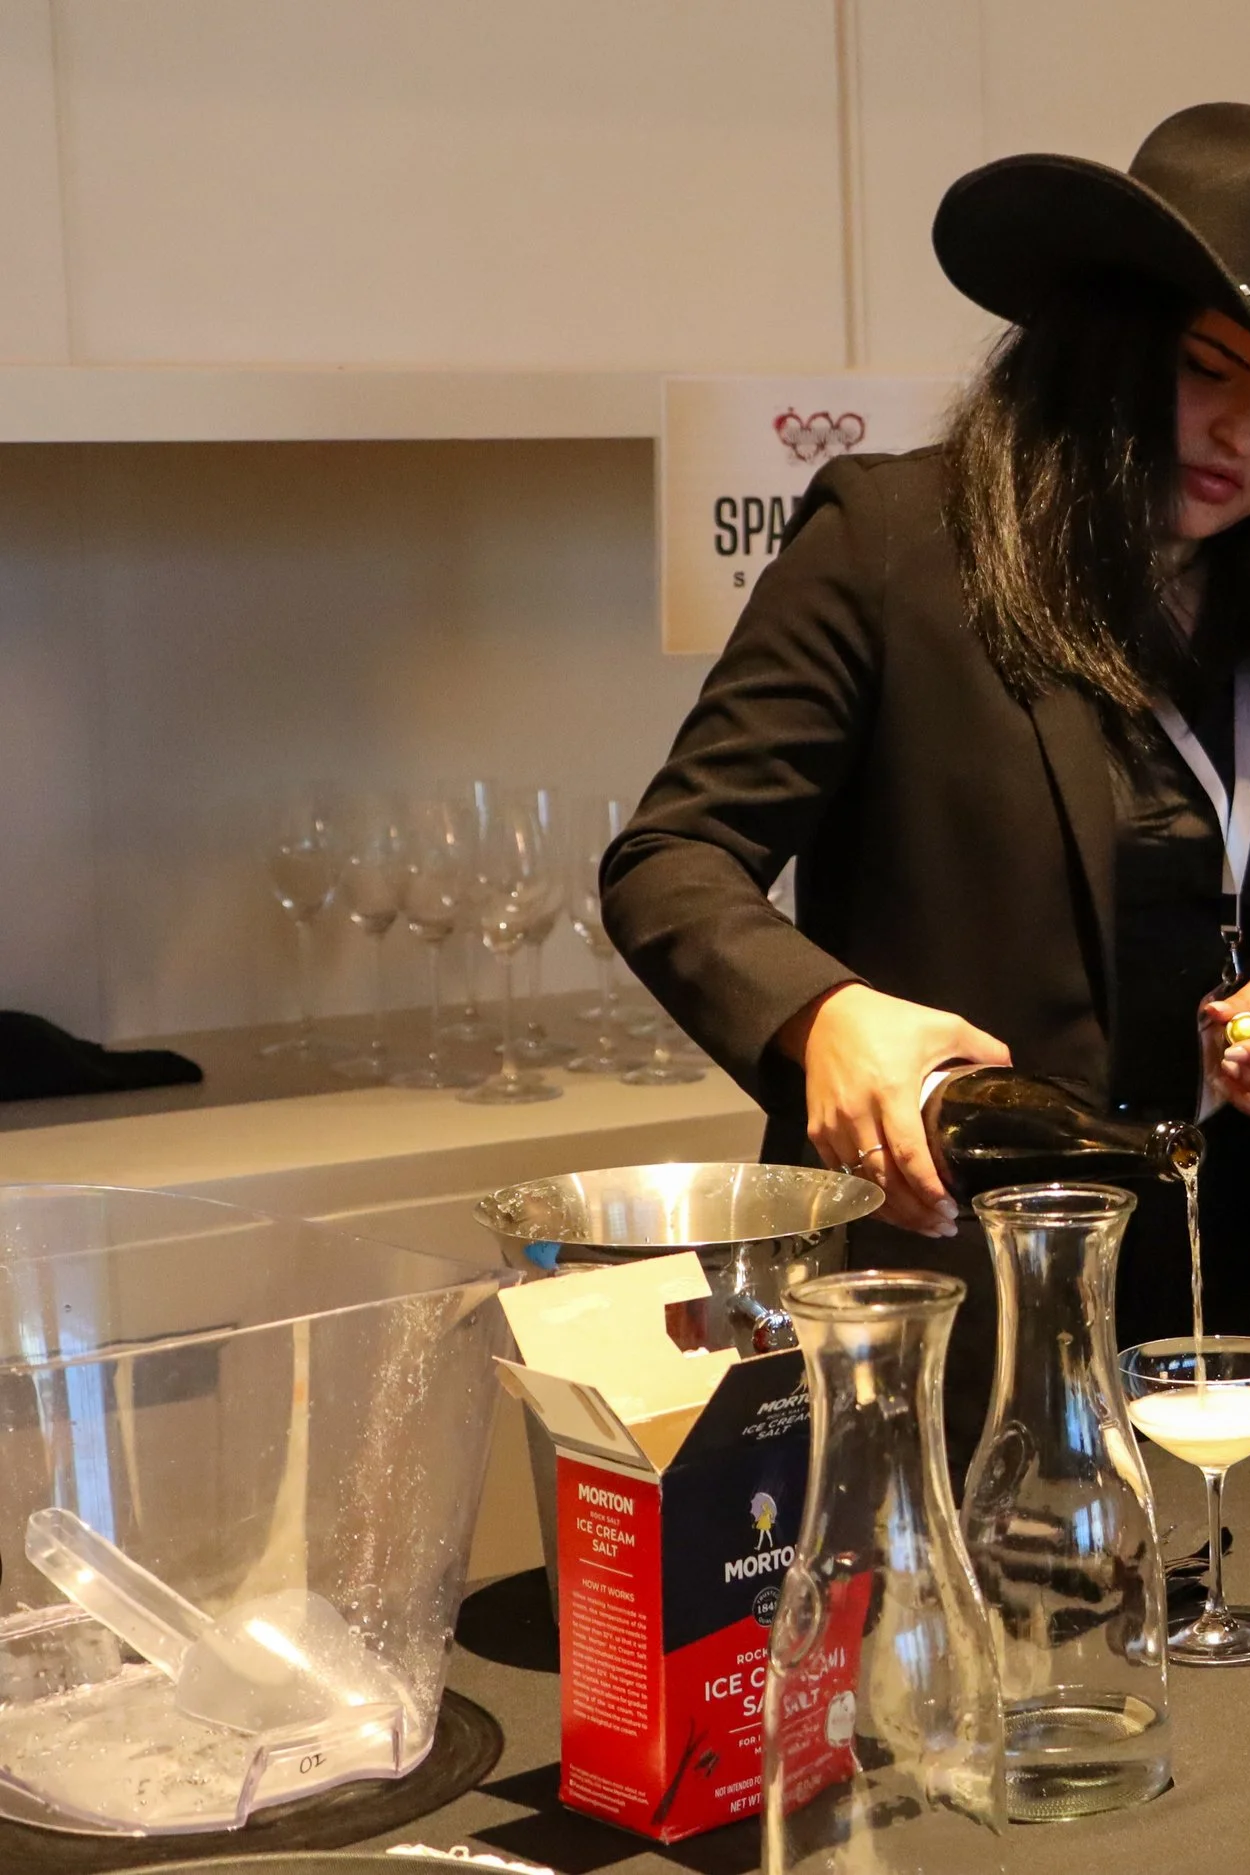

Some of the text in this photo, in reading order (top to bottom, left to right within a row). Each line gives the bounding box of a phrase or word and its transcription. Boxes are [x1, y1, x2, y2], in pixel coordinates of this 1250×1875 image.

[742, 1422, 766, 1435] ICE
[756, 1425, 791, 1440] SALT
[578, 1483, 633, 1516] MORTON
[577, 1517, 635, 1547] ICE CREAM
[592, 1539, 618, 1557] SALT
[725, 1544, 797, 1583] MORTO
[582, 1579, 635, 1602] HOW IT WORKS
[705, 1673, 743, 1701] ICE
[739, 1737, 755, 1748] FOR
[715, 1786, 727, 1798] NOT
[727, 1778, 753, 1795] INTENDED
[730, 1797, 746, 1813] NET
